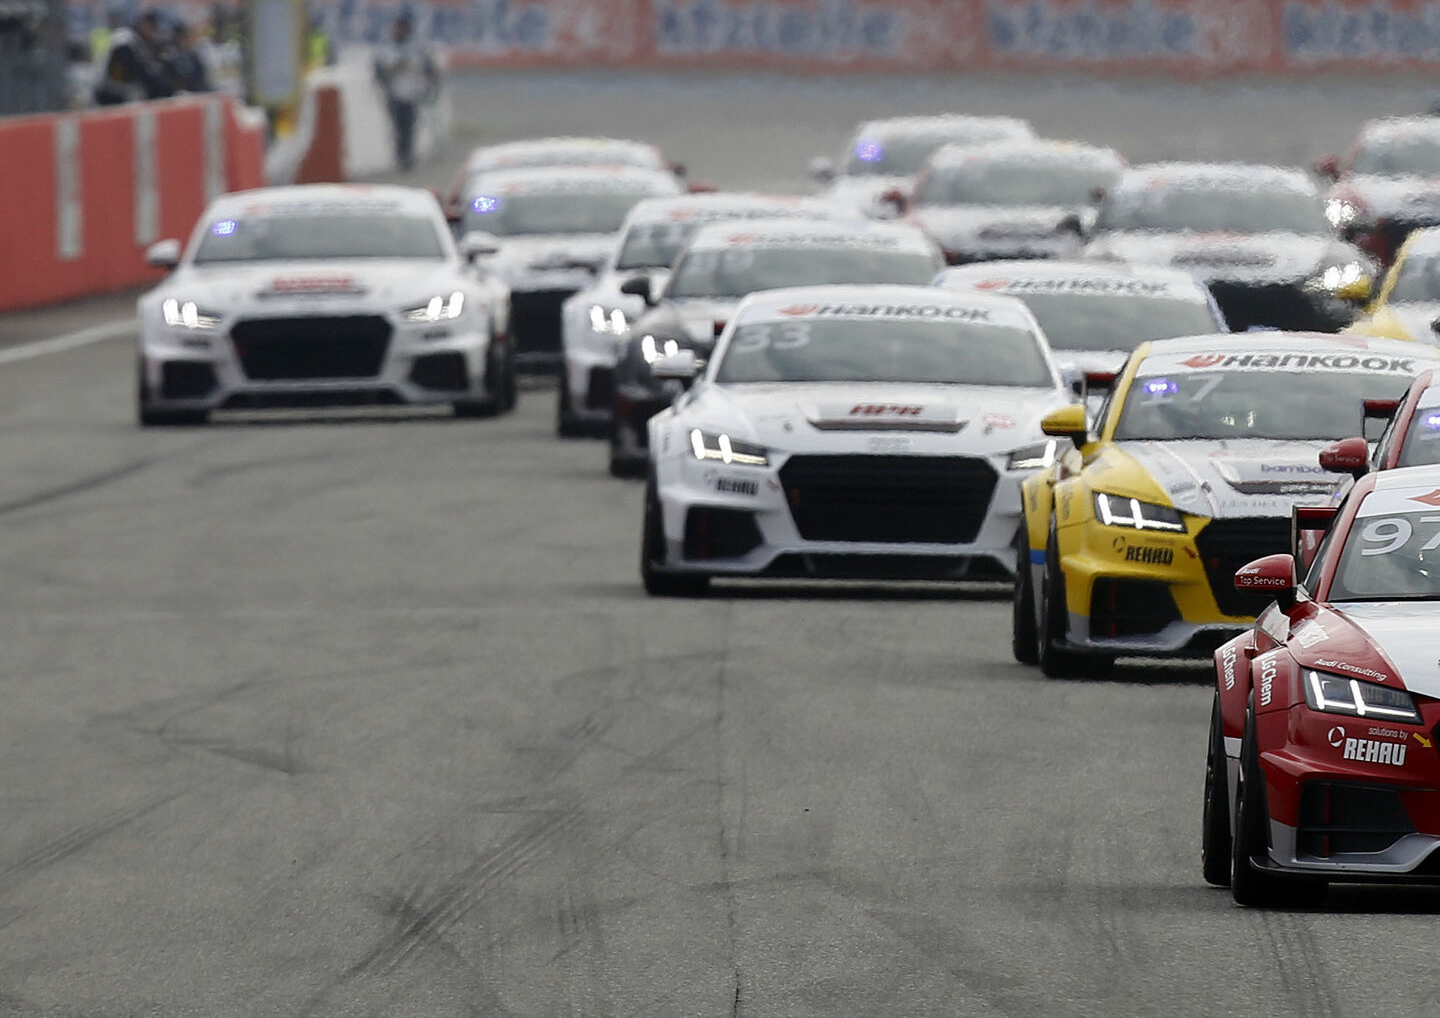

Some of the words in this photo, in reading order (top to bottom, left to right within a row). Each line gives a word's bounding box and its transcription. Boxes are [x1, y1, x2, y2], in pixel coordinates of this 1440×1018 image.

[737, 321, 812, 353] 33
[1252, 577, 1286, 586] Service
[1313, 658, 1337, 670] Audi
[1337, 662, 1388, 681] Consulting
[1368, 726, 1398, 739] solutions
[1399, 729, 1409, 741] by
[1343, 737, 1407, 766] REHAU
